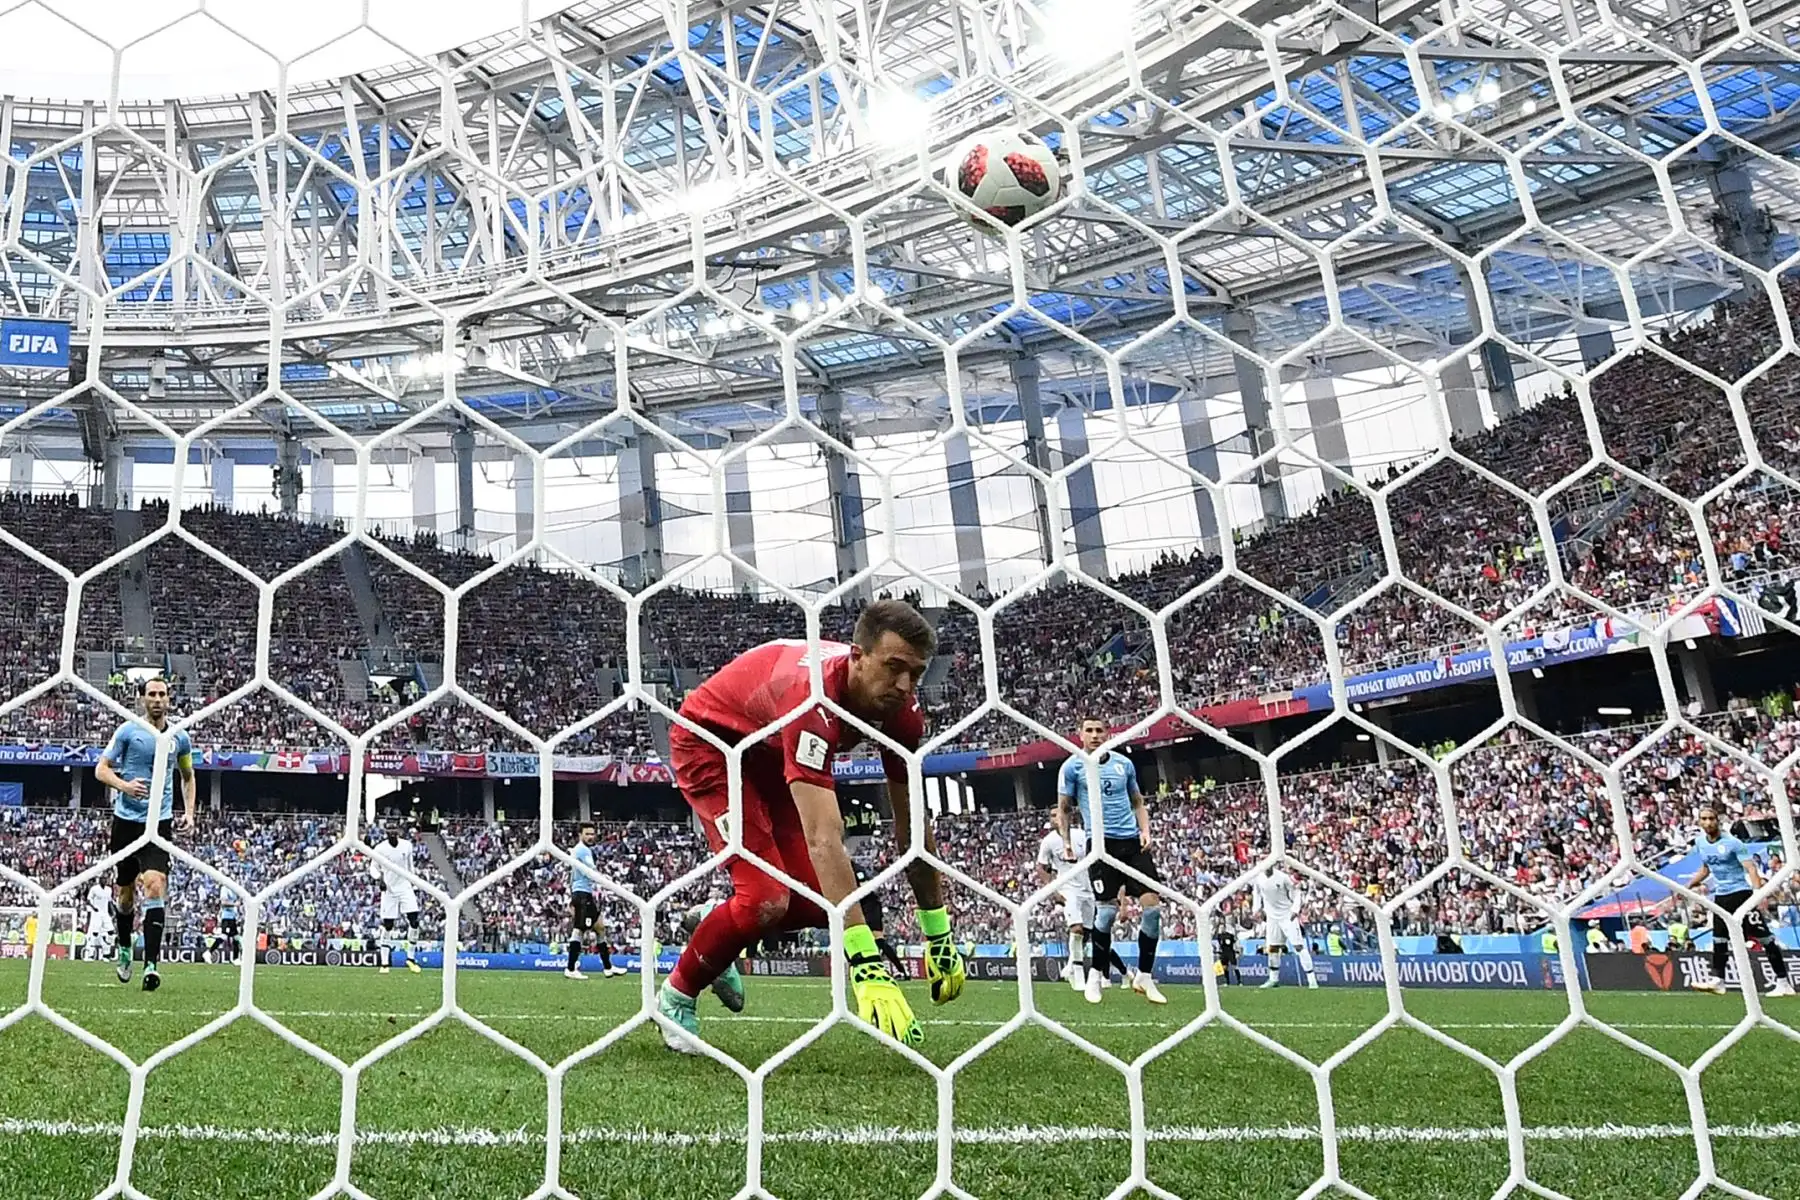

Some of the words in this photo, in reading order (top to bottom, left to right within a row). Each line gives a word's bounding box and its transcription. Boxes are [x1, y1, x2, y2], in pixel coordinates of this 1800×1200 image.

[9, 334, 58, 354] FIFA
[1415, 669, 1432, 684] ПО
[16, 751, 62, 761] ФУТБОЛУ
[1103, 780, 1113, 796] 2
[1748, 911, 1763, 925] 22
[160, 950, 195, 963] LUCI
[282, 952, 317, 965] LUCI
[343, 953, 377, 966] LUCI
[986, 962, 1000, 978] Get
[1343, 957, 1422, 983] НИЖИЙ
[1424, 962, 1528, 985] НОВГОРОД
